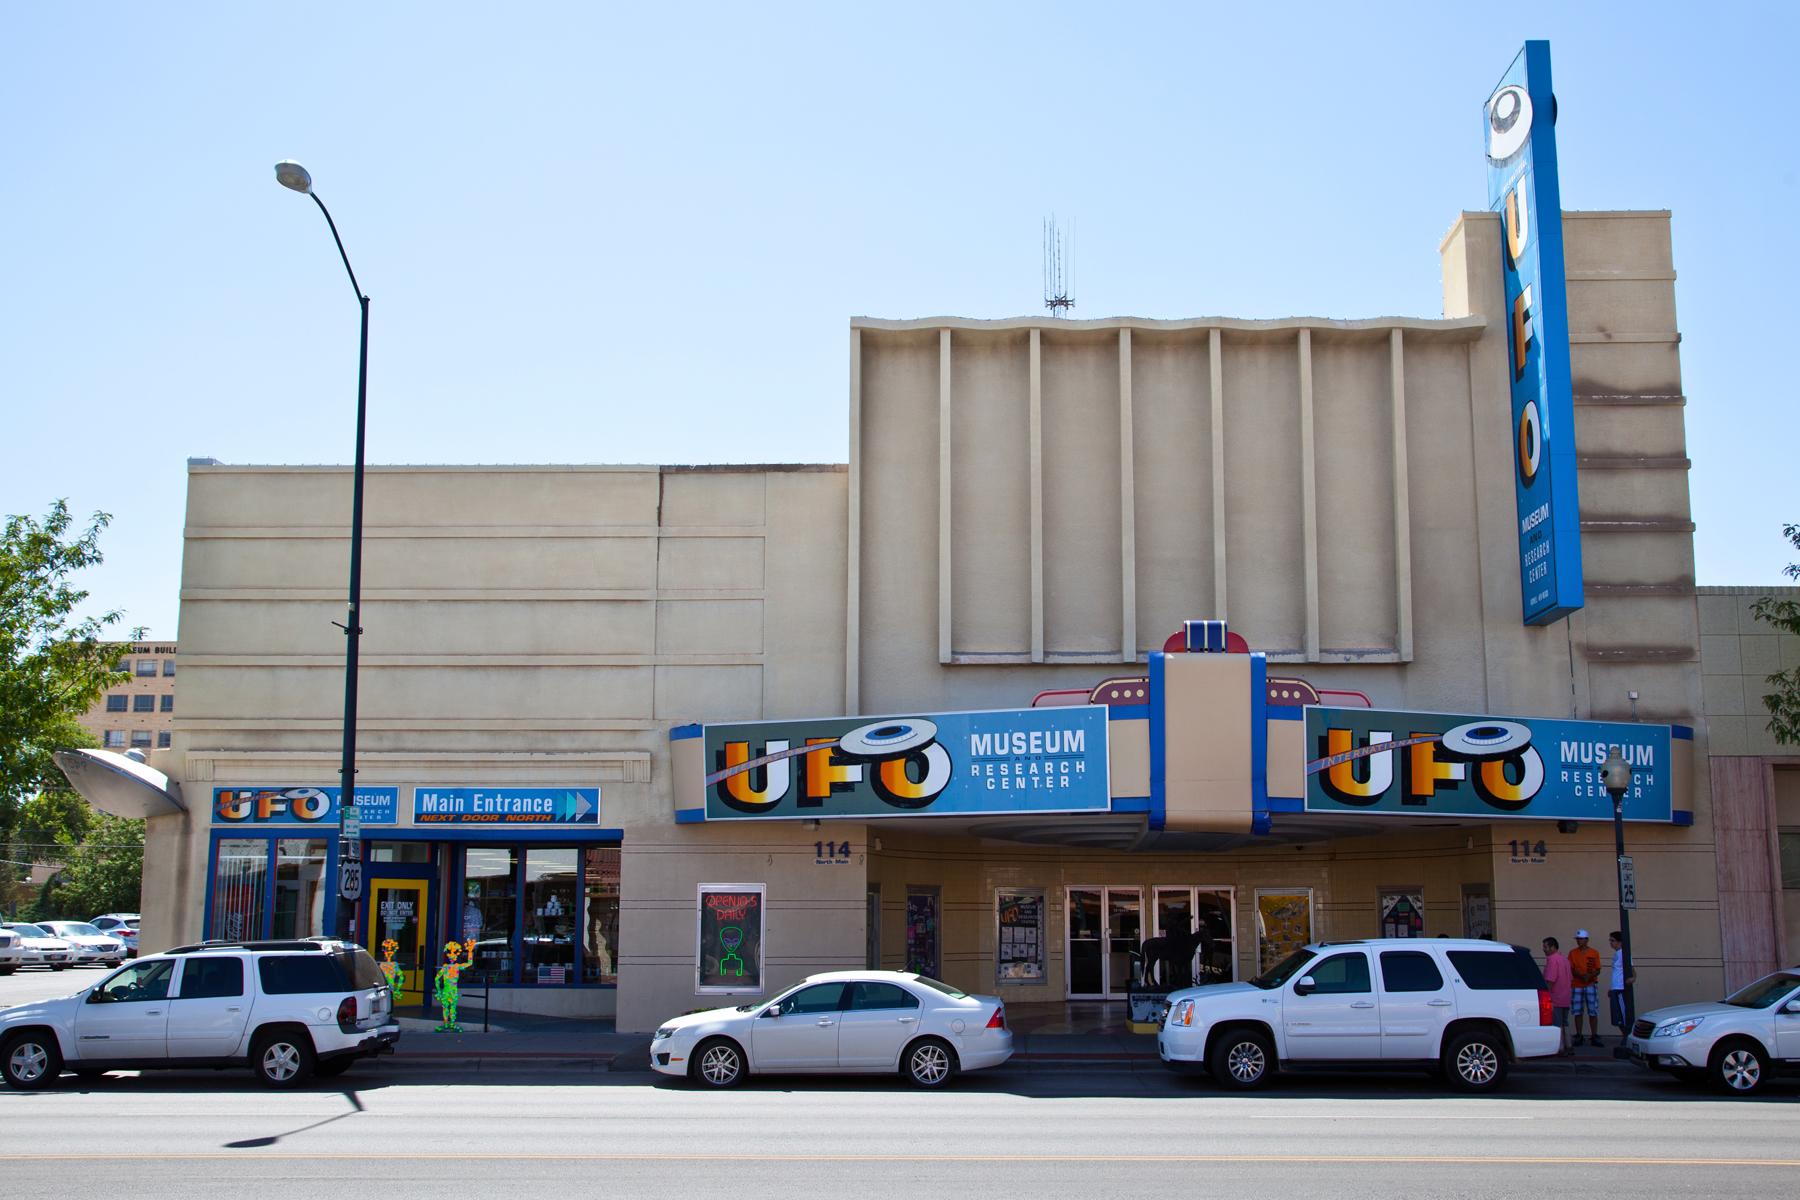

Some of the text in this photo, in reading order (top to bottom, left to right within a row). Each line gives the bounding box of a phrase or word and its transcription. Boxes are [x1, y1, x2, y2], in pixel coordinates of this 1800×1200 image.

[1522, 502, 1549, 534] MUSEUM
[1525, 541, 1550, 567] RESEARCH
[1529, 561, 1548, 584] CENTER
[970, 729, 1085, 756] MUSEUM
[1321, 738, 1418, 769] INTERNATIONAL
[722, 736, 952, 806] UFO
[971, 761, 1085, 777] RESEARCH
[1326, 728, 1545, 803] UFO
[986, 775, 1070, 790] CENTER
[1561, 770, 1654, 785] RESECH
[336, 795, 390, 806] MSEUM
[1575, 785, 1642, 798] CENER
[218, 789, 332, 820] UFO
[422, 793, 553, 812] Main Entrance
[420, 814, 553, 822] NEXT DOOR NORTH
[814, 840, 852, 857] 114
[1508, 839, 1548, 857] 114
[344, 869, 360, 892] 285
[705, 895, 737, 907] OPEN
[1624, 884, 1634, 903] 25
[380, 901, 414, 910] EXIT ONLY
[716, 908, 746, 921] DAILY
